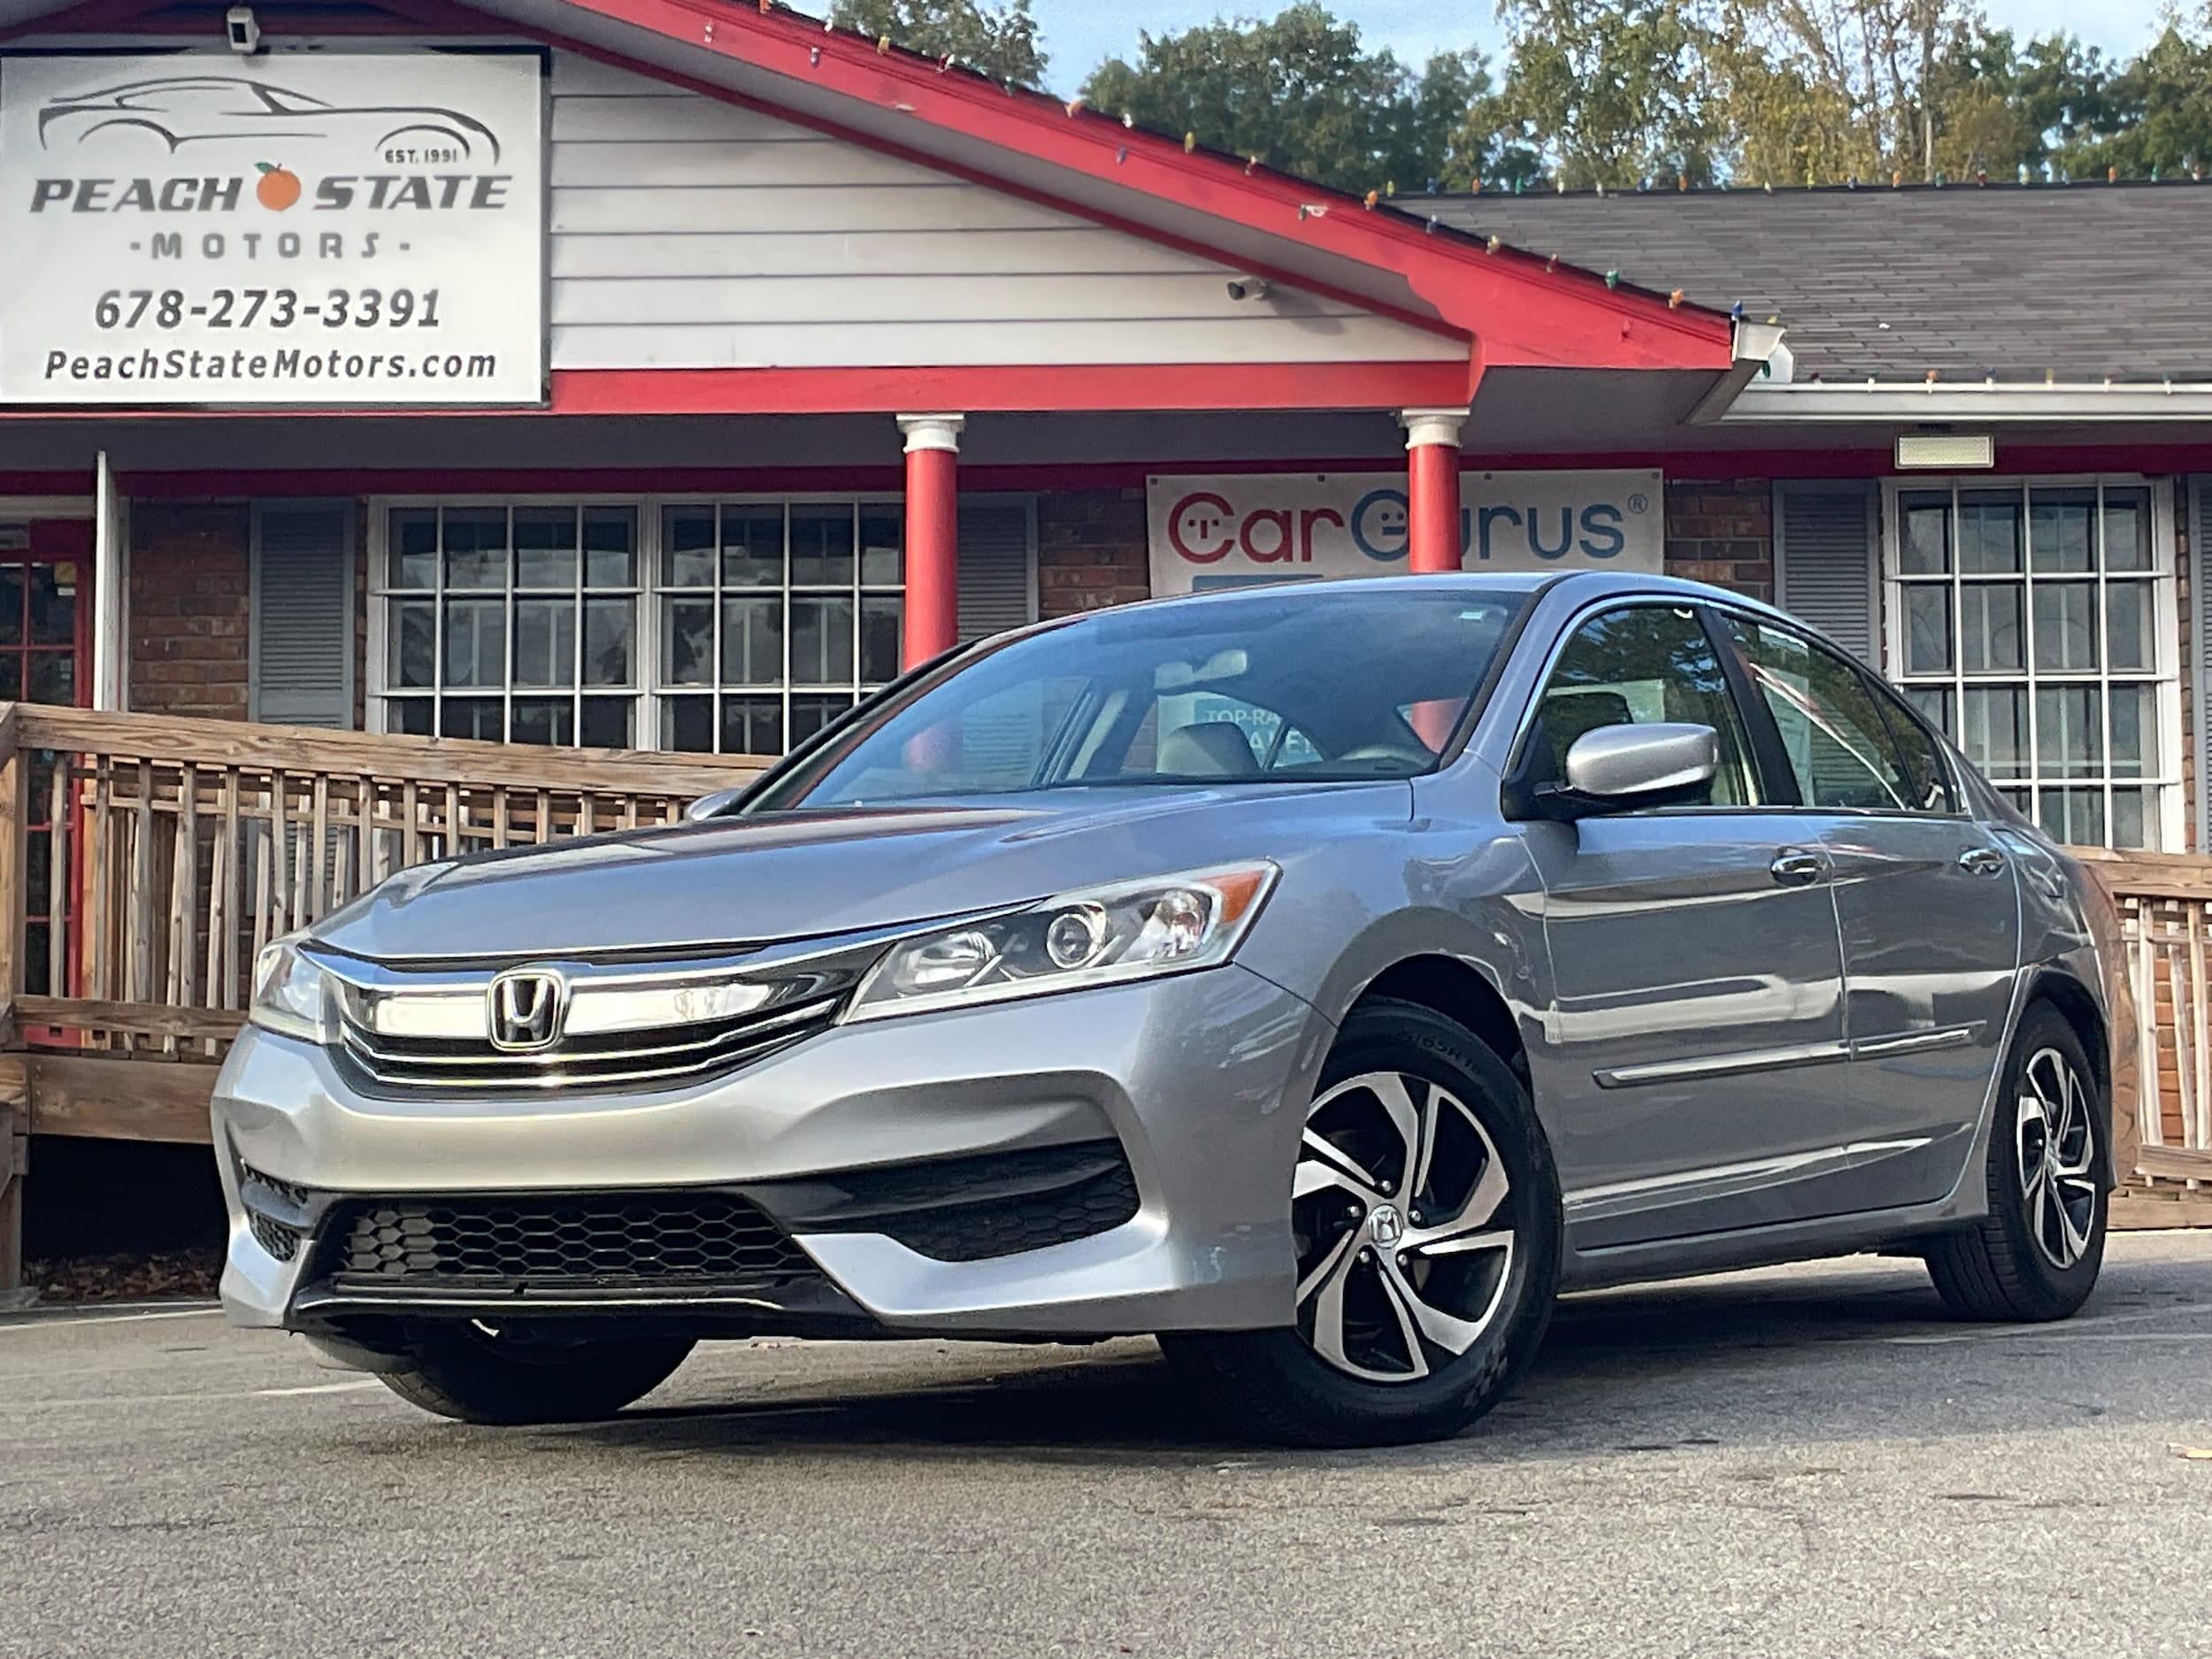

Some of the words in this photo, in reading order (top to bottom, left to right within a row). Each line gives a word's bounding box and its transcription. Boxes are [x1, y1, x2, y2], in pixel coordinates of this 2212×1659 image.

[424, 148, 457, 164] 1991
[29, 177, 243, 213] PEACH
[314, 174, 512, 211] STATE
[96, 288, 440, 329] 678-273-3391
[45, 349, 496, 380] PeachStateMotors.com
